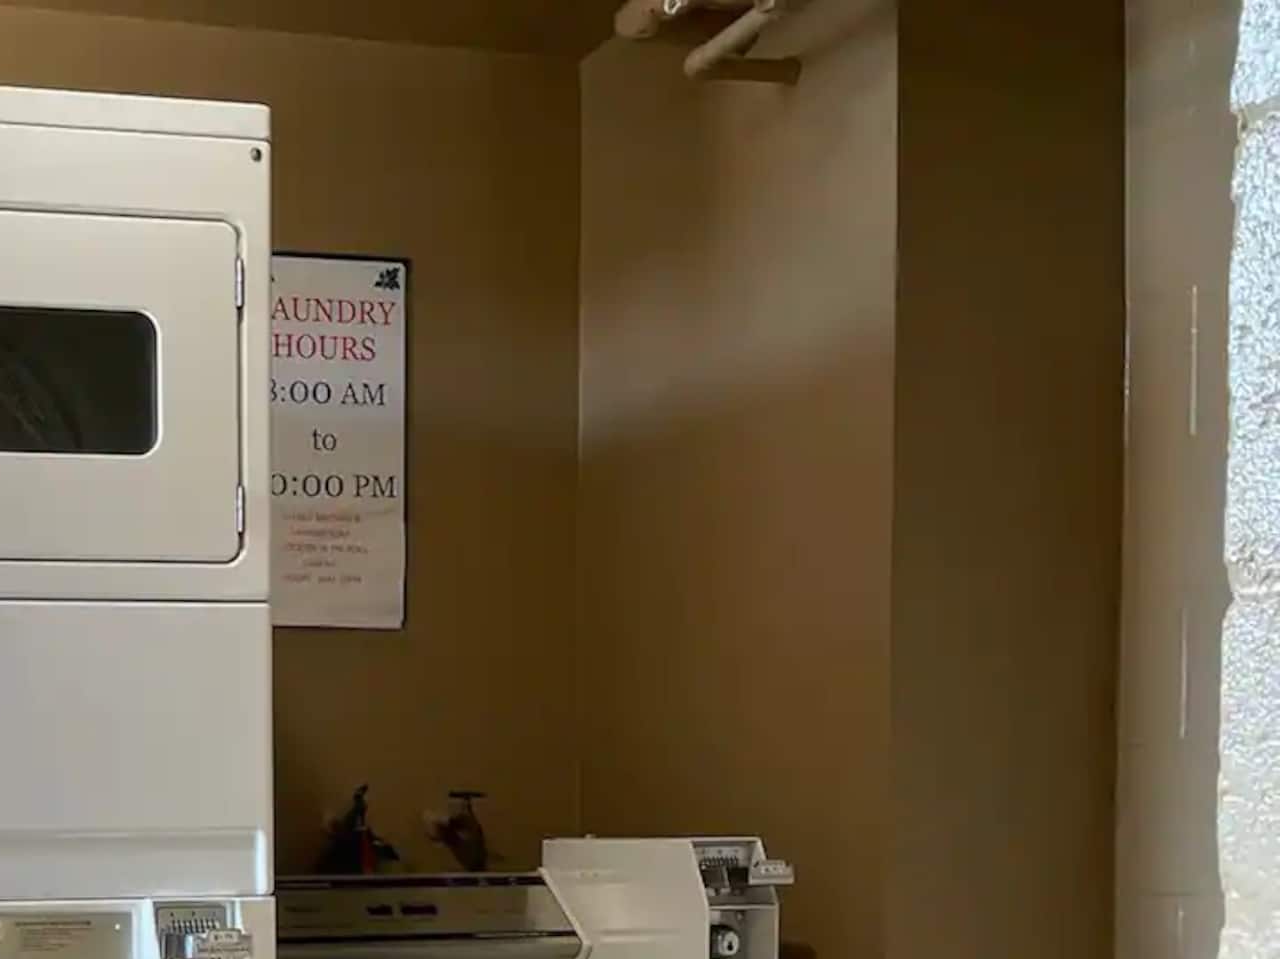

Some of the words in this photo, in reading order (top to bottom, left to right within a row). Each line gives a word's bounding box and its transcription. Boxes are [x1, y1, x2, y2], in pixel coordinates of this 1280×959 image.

[271, 296, 395, 325] AUNDRY
[273, 333, 376, 361] HOURS
[340, 381, 385, 406] AM
[312, 428, 337, 451] to
[272, 473, 344, 497] 0:00
[353, 474, 397, 498] PM
